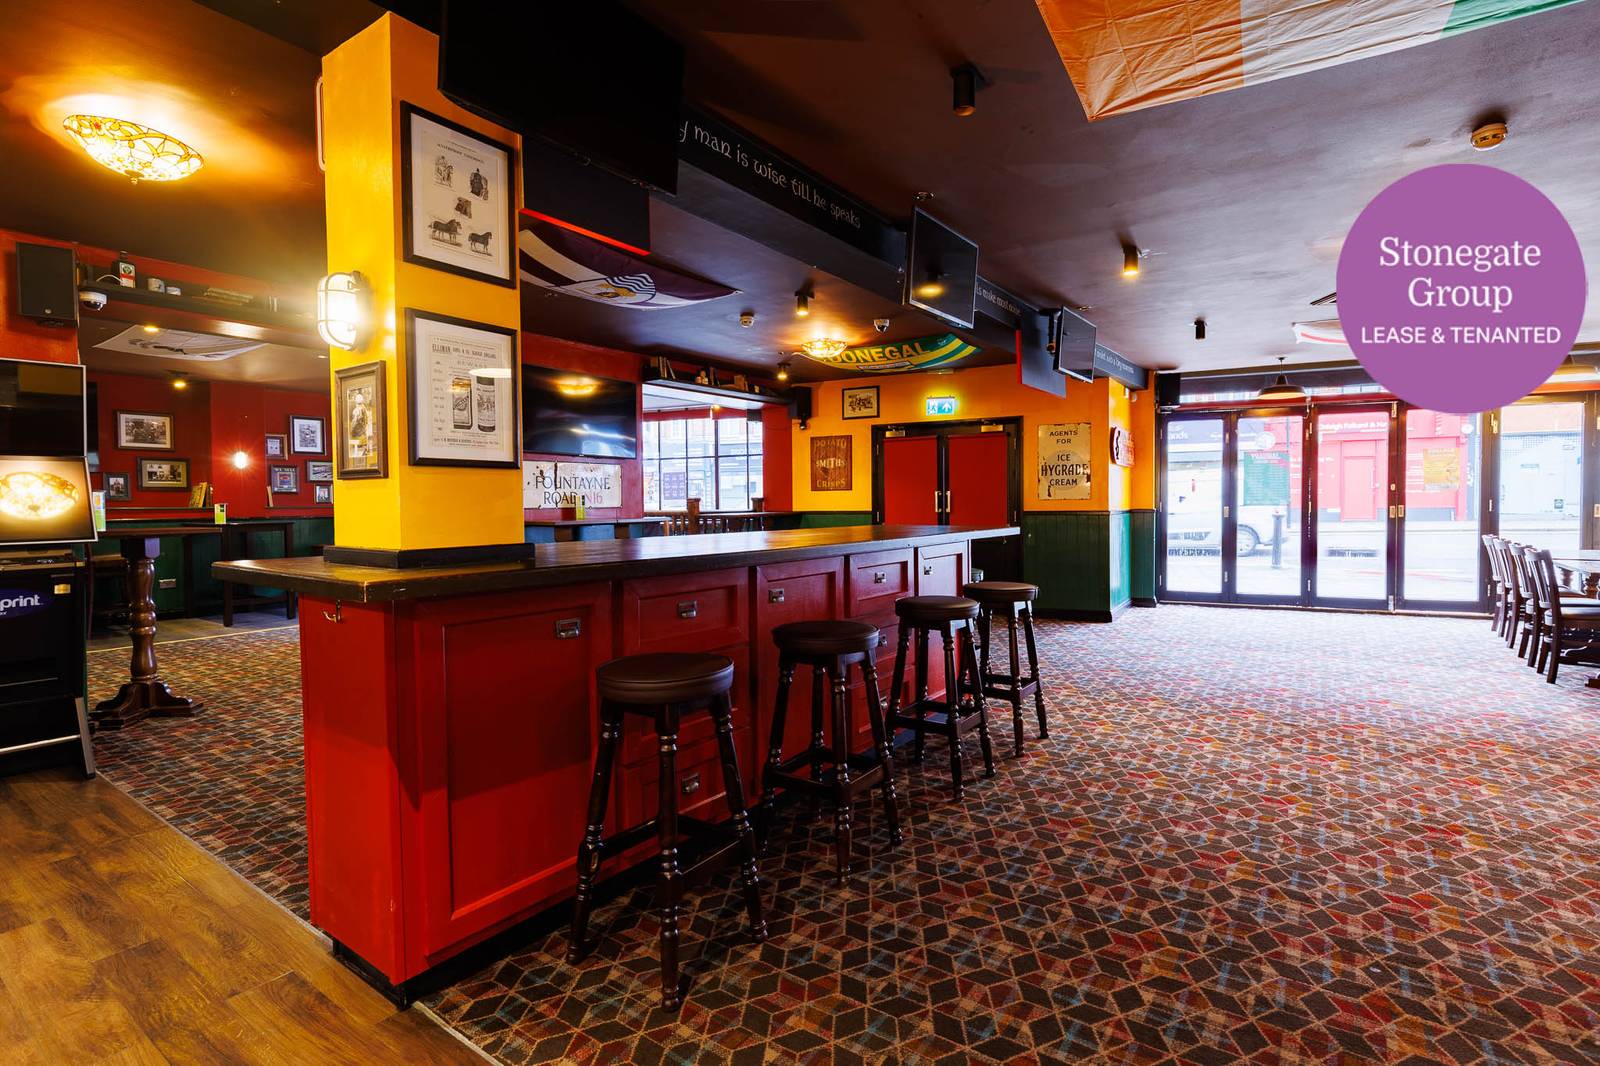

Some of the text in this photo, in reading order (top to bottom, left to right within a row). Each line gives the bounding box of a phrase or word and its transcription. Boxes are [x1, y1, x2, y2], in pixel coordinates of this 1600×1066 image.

[694, 125, 732, 158] man
[736, 144, 749, 168] is
[753, 160, 788, 188] wise
[790, 178, 812, 203] till
[813, 189, 827, 211] he
[830, 203, 861, 229] speaks
[1049, 429, 1078, 437] AGENTS
[814, 438, 847, 450] POTATO
[1057, 453, 1071, 462] ICE
[1041, 463, 1089, 477] HYGRADE
[535, 475, 611, 491] FOUNTAYNE
[816, 478, 846, 488] CRISPS
[544, 491, 603, 505] ROAD N16
